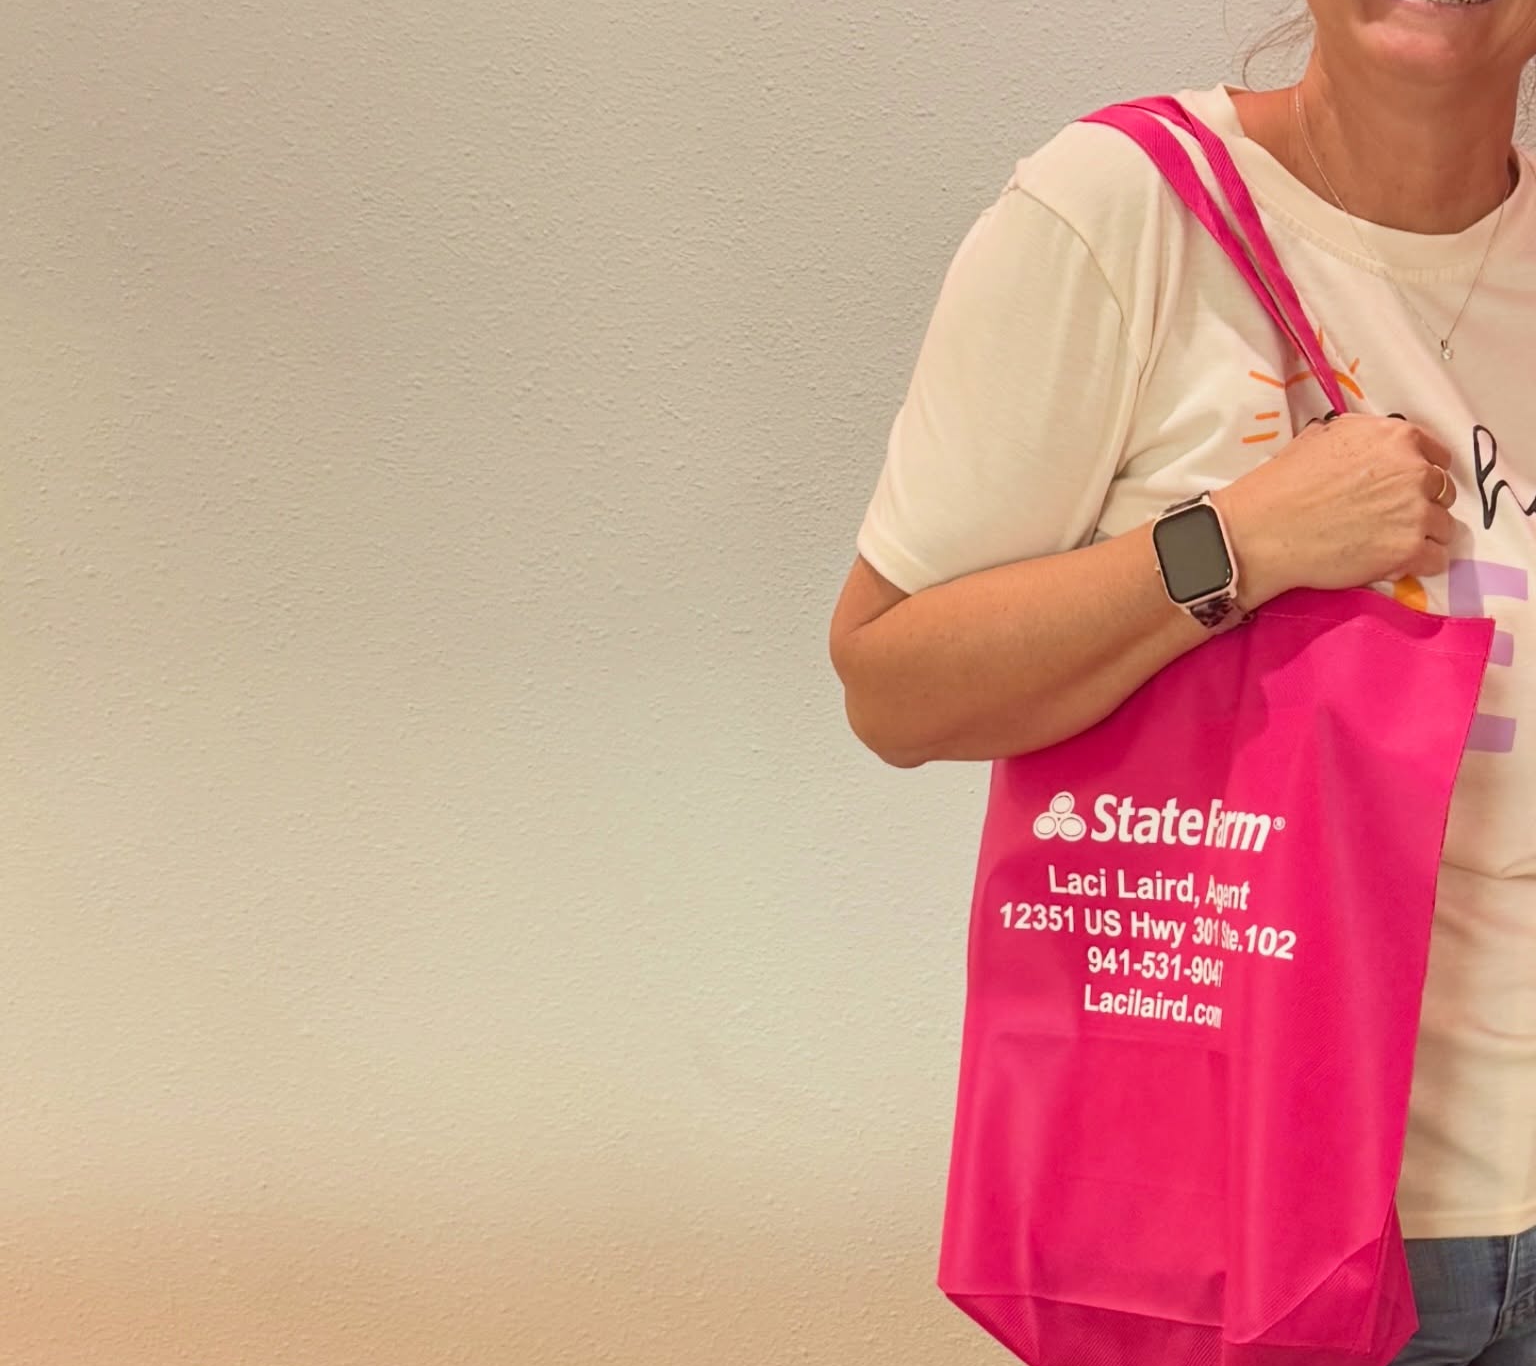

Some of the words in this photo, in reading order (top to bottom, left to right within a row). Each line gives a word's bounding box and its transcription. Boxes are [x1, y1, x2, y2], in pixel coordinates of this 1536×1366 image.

[1047, 864, 1108, 898] Laci
[1116, 868, 1201, 909] Laird,
[1204, 874, 1252, 915] Agent
[999, 901, 1075, 934] 12351
[1083, 907, 1123, 937] US
[1130, 911, 1187, 950] Hwy
[1191, 916, 1219, 947] 301
